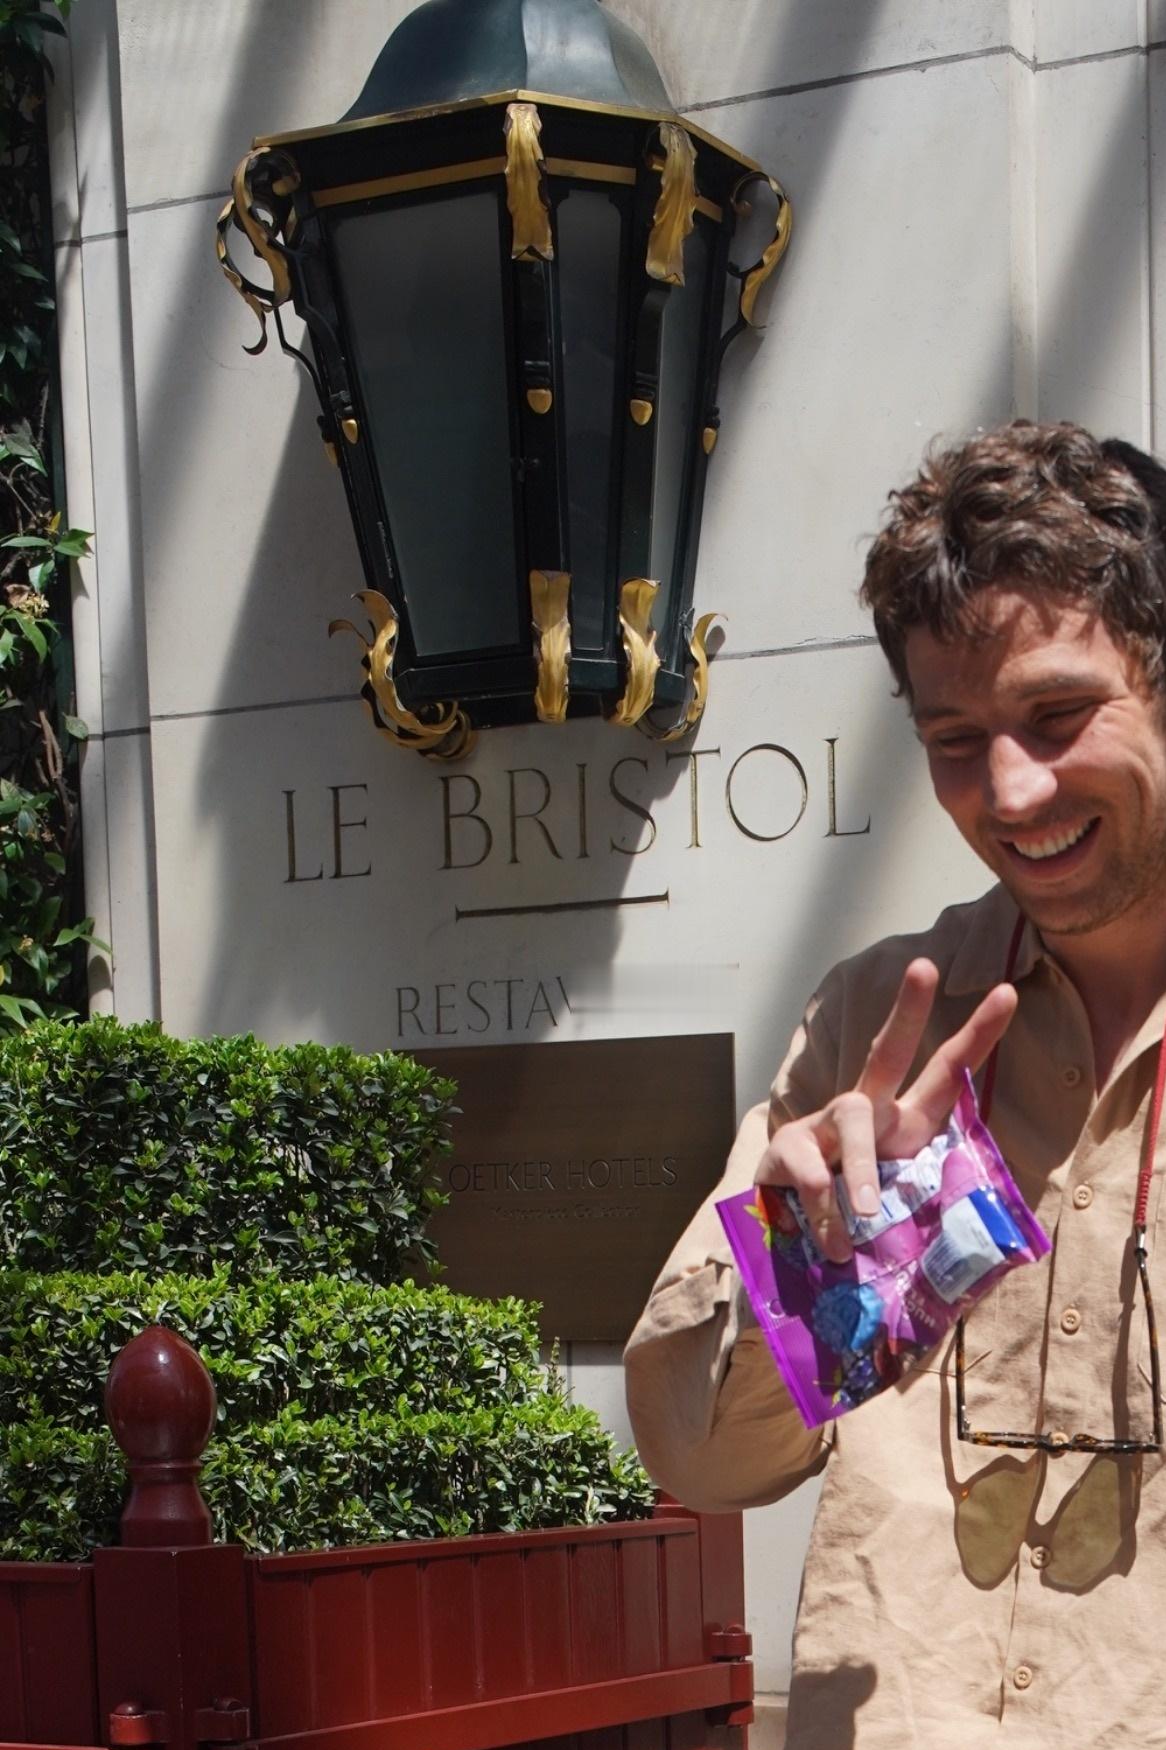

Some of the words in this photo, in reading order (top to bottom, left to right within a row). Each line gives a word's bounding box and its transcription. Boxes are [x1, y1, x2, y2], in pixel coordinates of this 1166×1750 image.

[282, 783, 373, 884] LE
[437, 737, 871, 872] BRISTOL
[449, 1161, 557, 1193] OETKER
[567, 1156, 679, 1190] HOTELS
